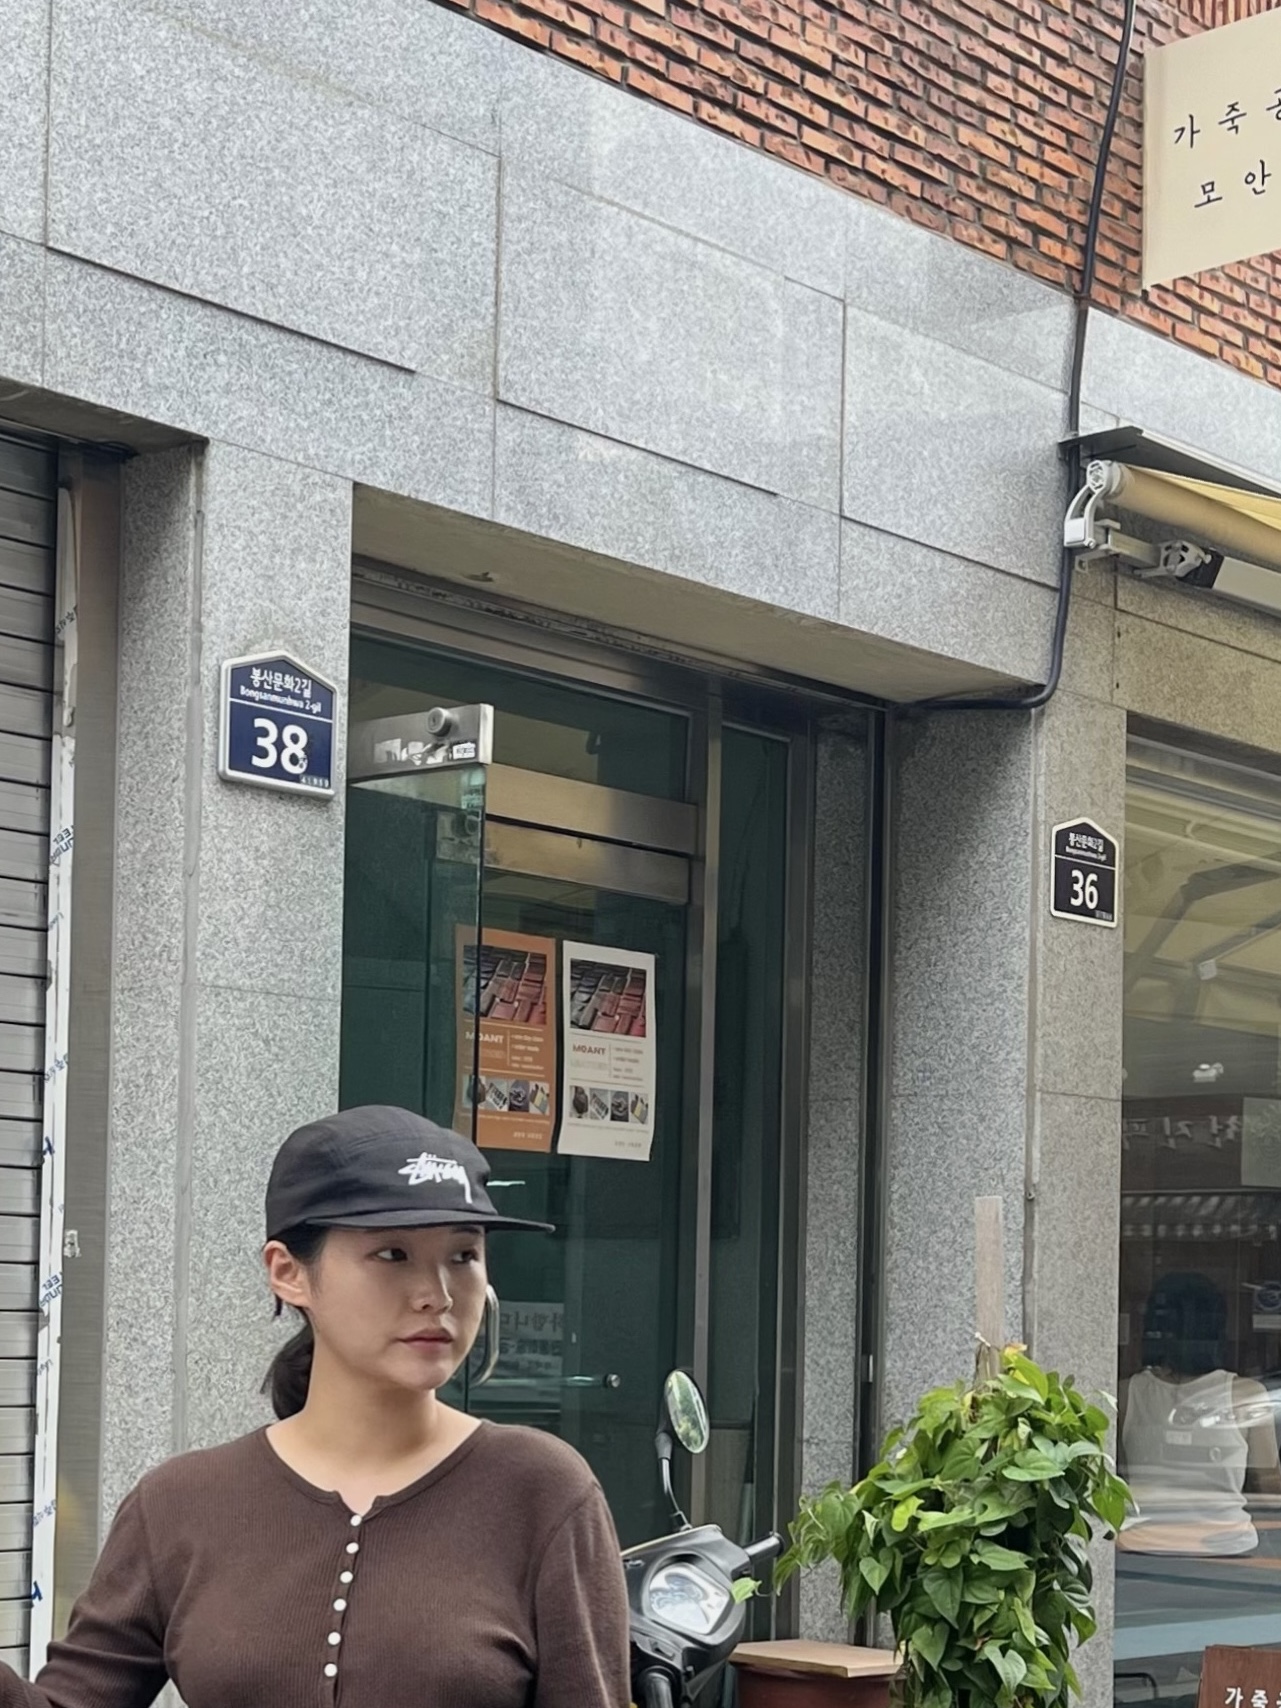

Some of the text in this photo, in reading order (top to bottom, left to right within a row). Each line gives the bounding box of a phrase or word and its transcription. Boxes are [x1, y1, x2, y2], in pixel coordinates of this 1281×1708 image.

[249, 667, 312, 699] 봉산문화2길
[251, 717, 308, 774] 38
[1070, 869, 1099, 910] 36
